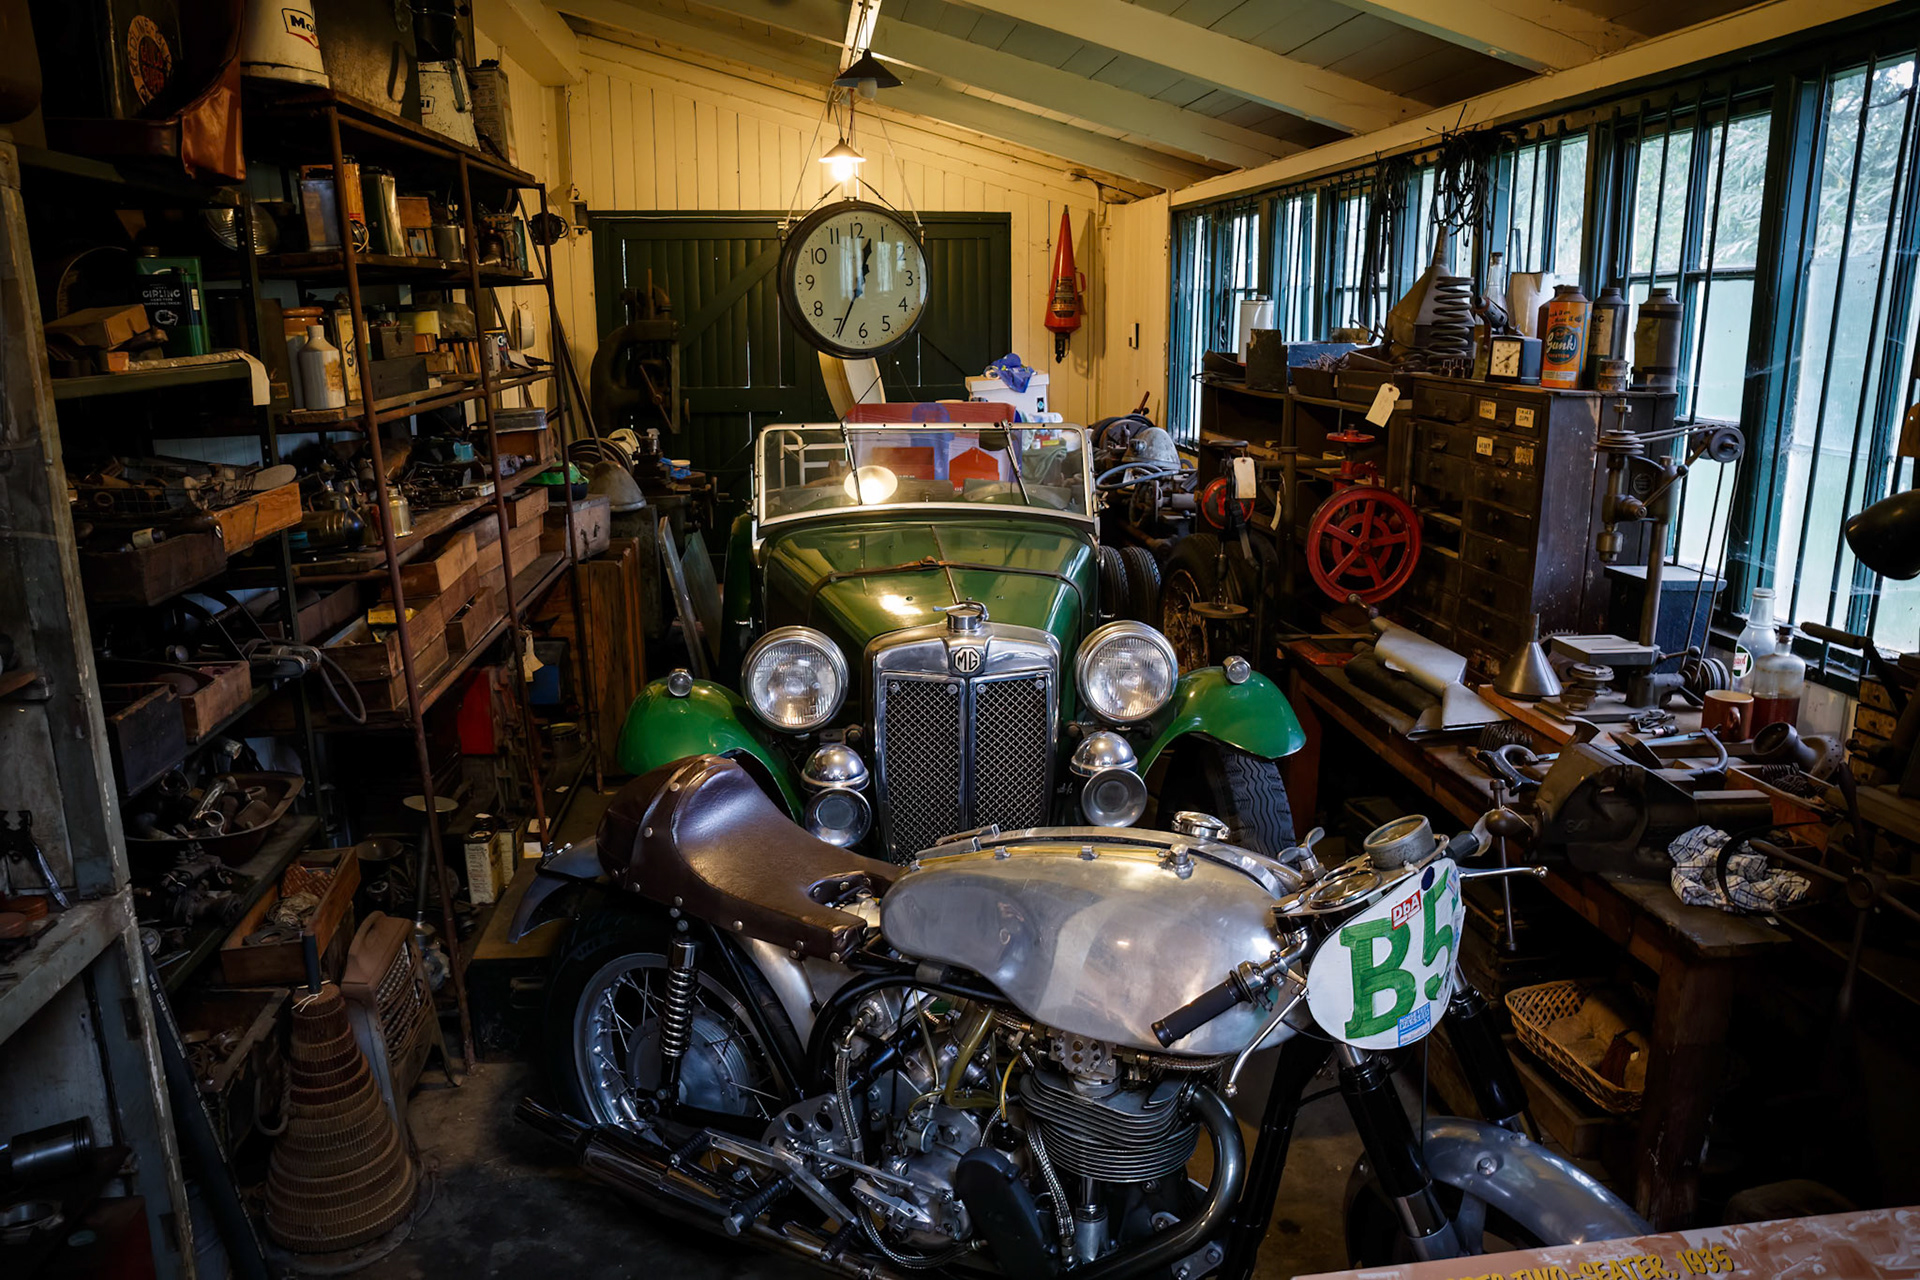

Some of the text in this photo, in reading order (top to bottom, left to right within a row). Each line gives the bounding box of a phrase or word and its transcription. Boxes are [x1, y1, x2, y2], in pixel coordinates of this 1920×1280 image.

[829, 227, 840, 245] 11
[850, 222, 865, 240] 12
[880, 226, 885, 243] 1
[810, 247, 828, 265] 10
[895, 244, 907, 261] 2
[804, 274, 815, 291] 9
[905, 270, 914, 287] 3
[142, 289, 181, 298] GIRLING
[813, 300, 824, 317] 8
[898, 296, 909, 312] 4
[833, 318, 843, 335] 7
[858, 321, 869, 338] 6
[881, 315, 891, 332] 5
[1546, 331, 1577, 353] Gunk
[957, 650, 978, 671] MG
[1392, 895, 1421, 922] DbA
[1676, 1245, 1735, 1276] 1935
